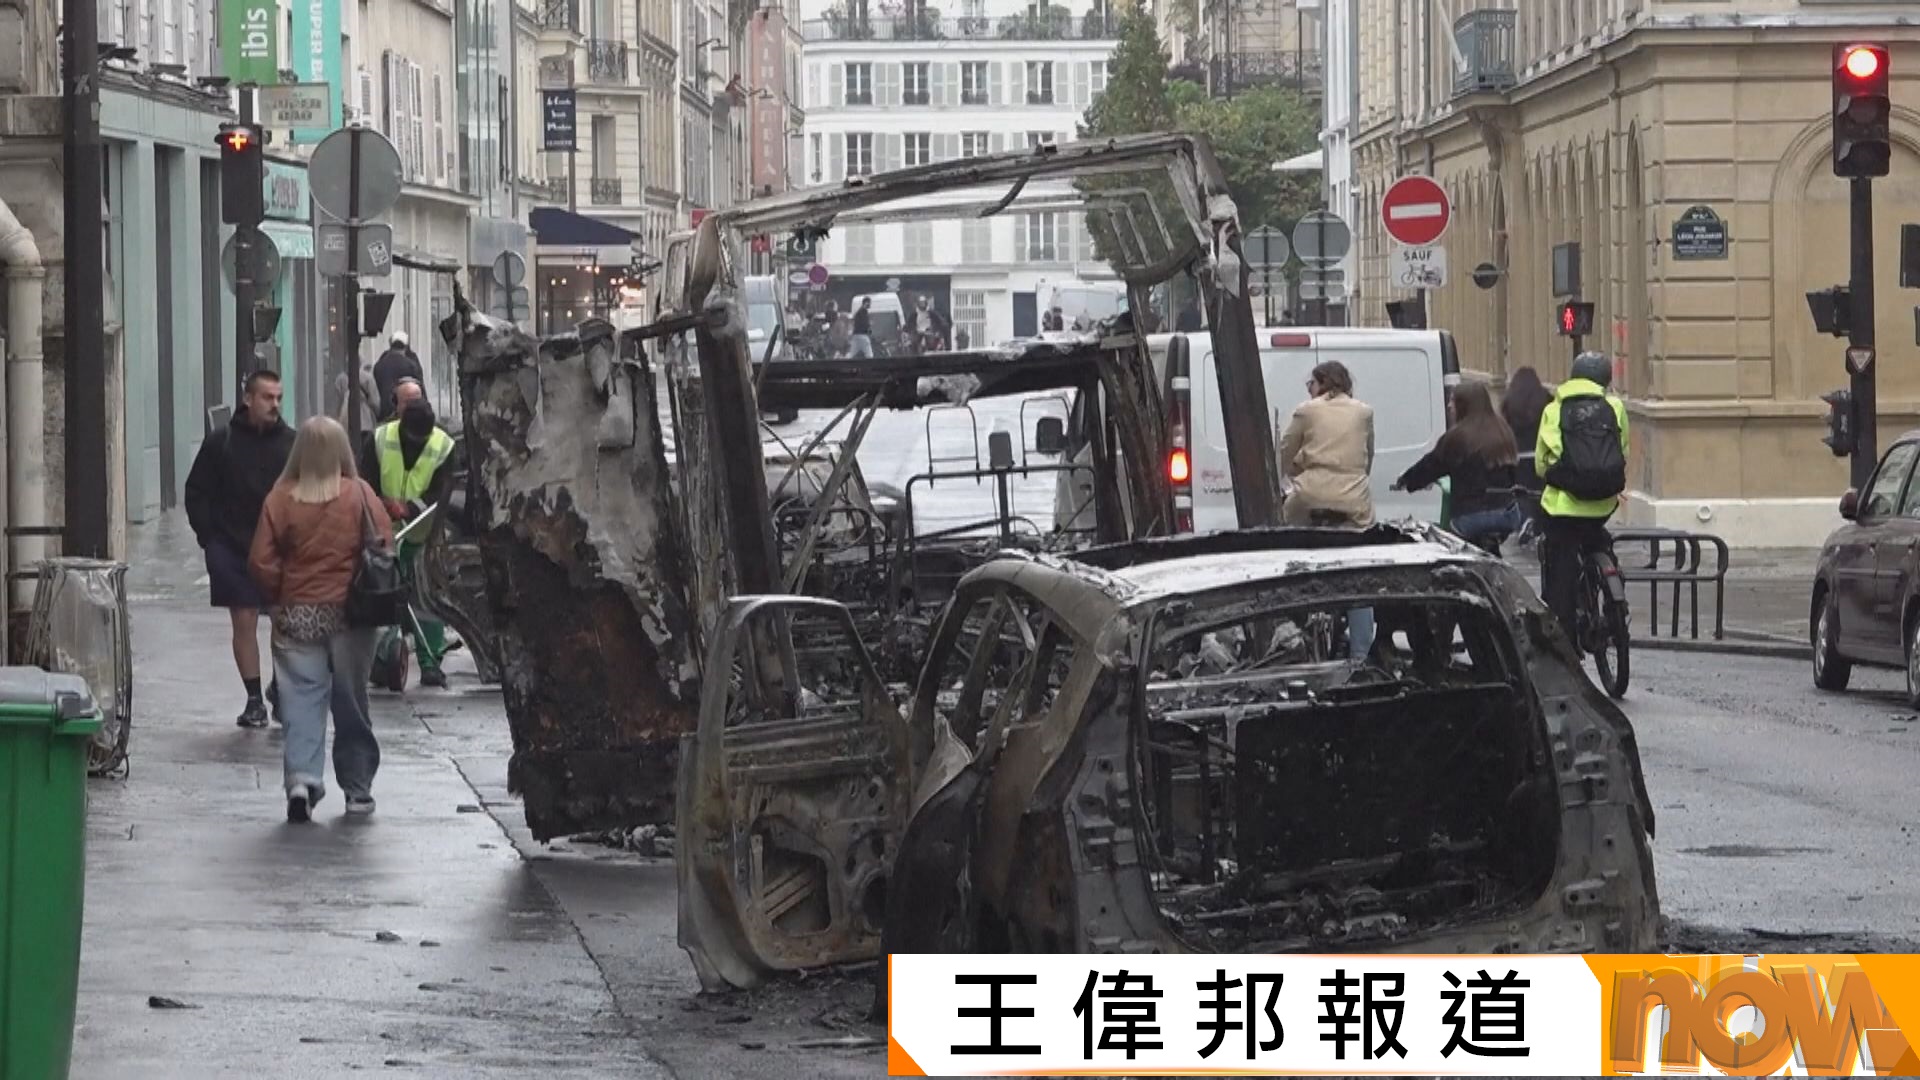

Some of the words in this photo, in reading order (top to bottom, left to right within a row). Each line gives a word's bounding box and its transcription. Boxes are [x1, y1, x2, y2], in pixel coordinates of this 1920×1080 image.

[240, 8, 268, 57] ibis
[310, 0, 323, 54] UPER
[1403, 250, 1432, 261] SAUF
